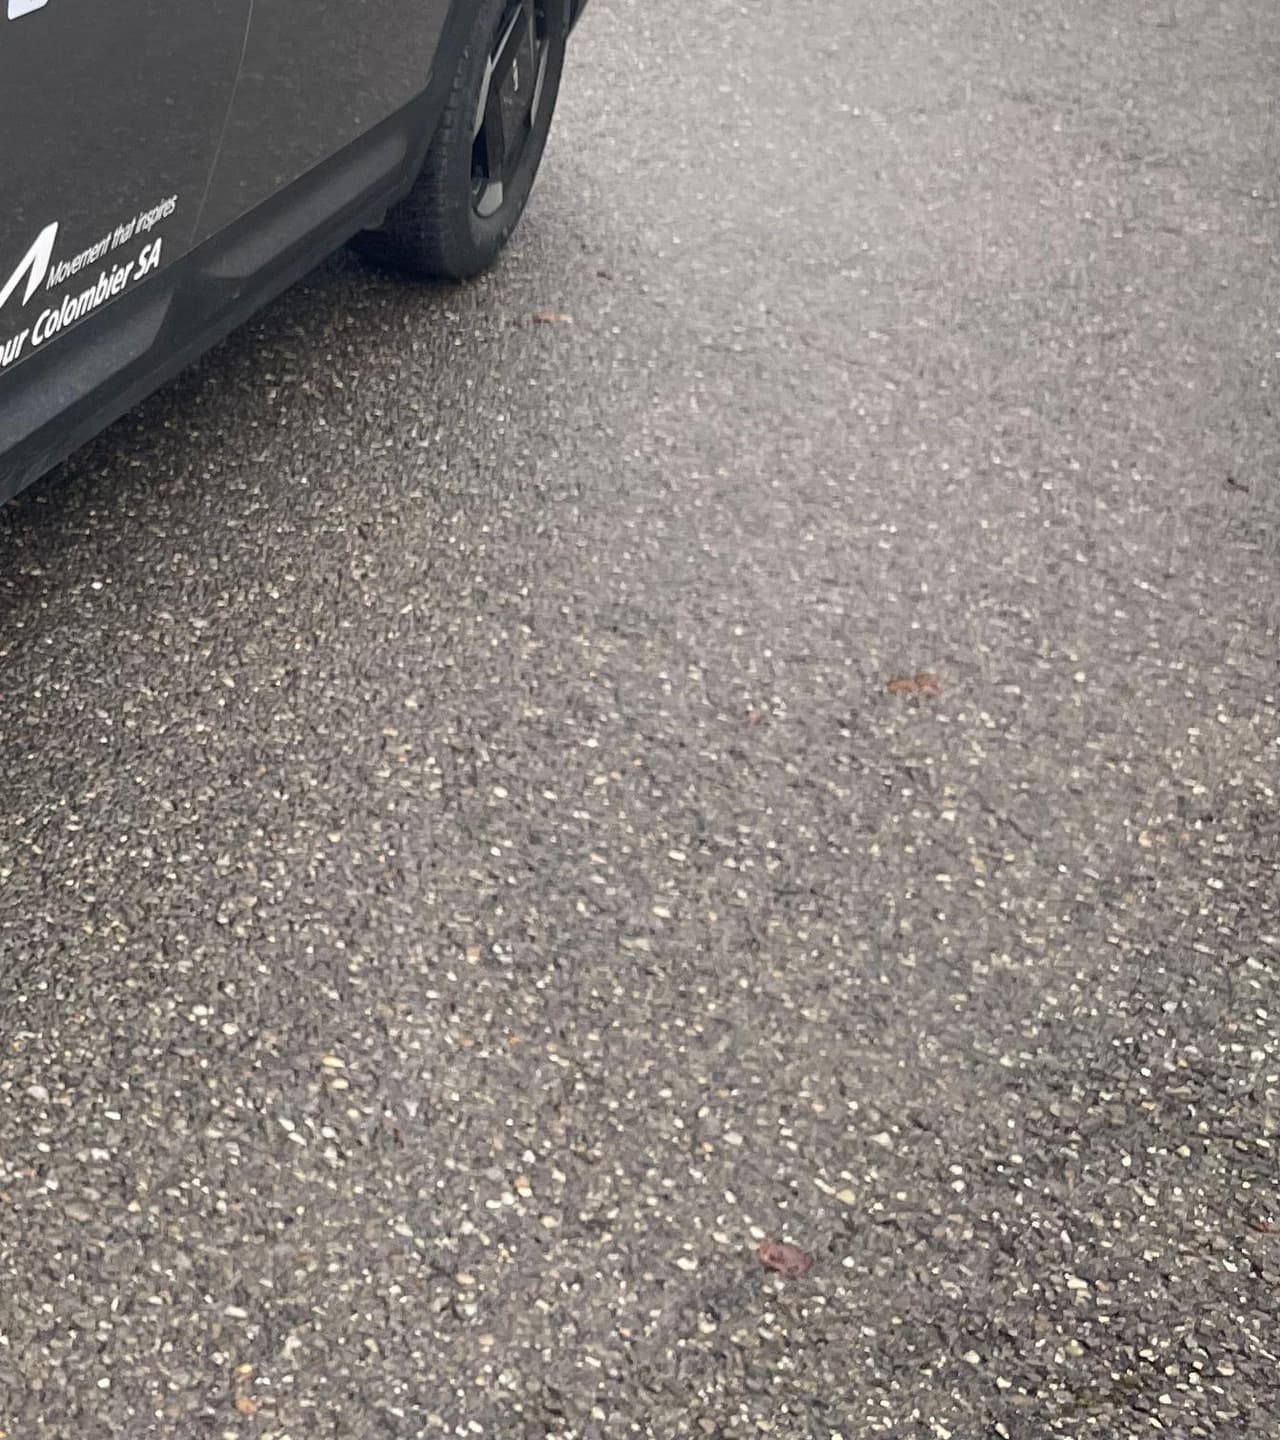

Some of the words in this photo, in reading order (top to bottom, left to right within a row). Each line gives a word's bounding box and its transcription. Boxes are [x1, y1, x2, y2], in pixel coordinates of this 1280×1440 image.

[31, 260, 135, 347] Colombier
[133, 237, 162, 281] SA
[45, 232, 112, 291] Movement
[111, 215, 137, 250] that
[135, 194, 178, 233] inspires
